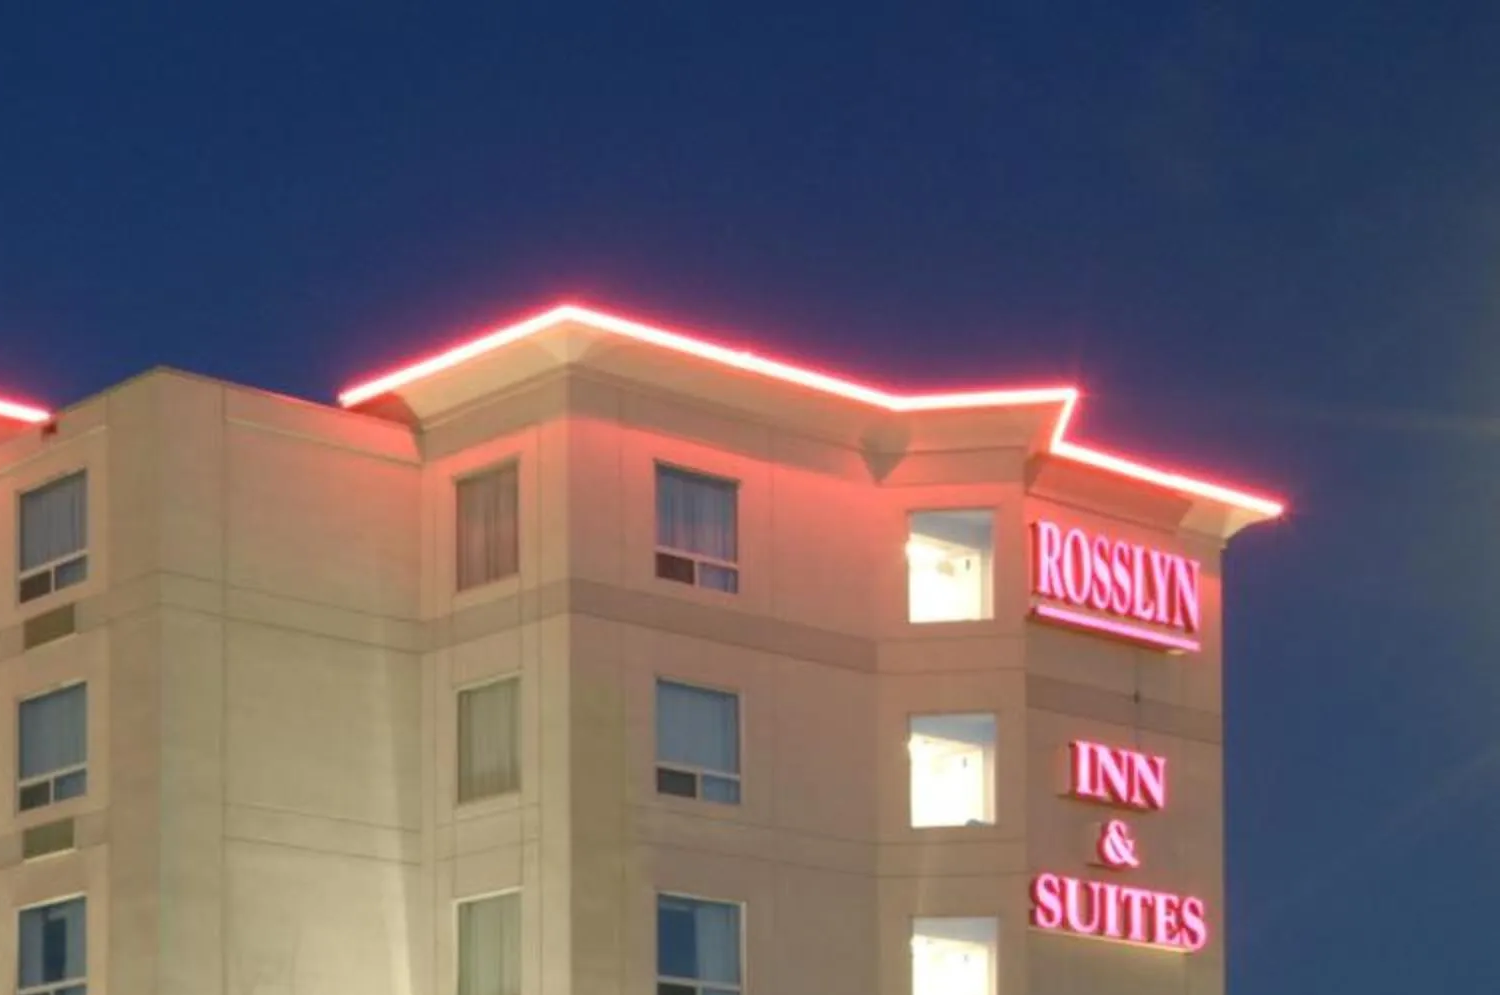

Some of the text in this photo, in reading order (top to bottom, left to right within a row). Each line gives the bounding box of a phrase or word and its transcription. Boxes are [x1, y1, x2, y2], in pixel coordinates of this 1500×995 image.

[1034, 519, 1201, 632] ROSSLYN
[1073, 740, 1166, 808] INN
[1101, 820, 1139, 867] &
[1033, 873, 1207, 952] SUITES
